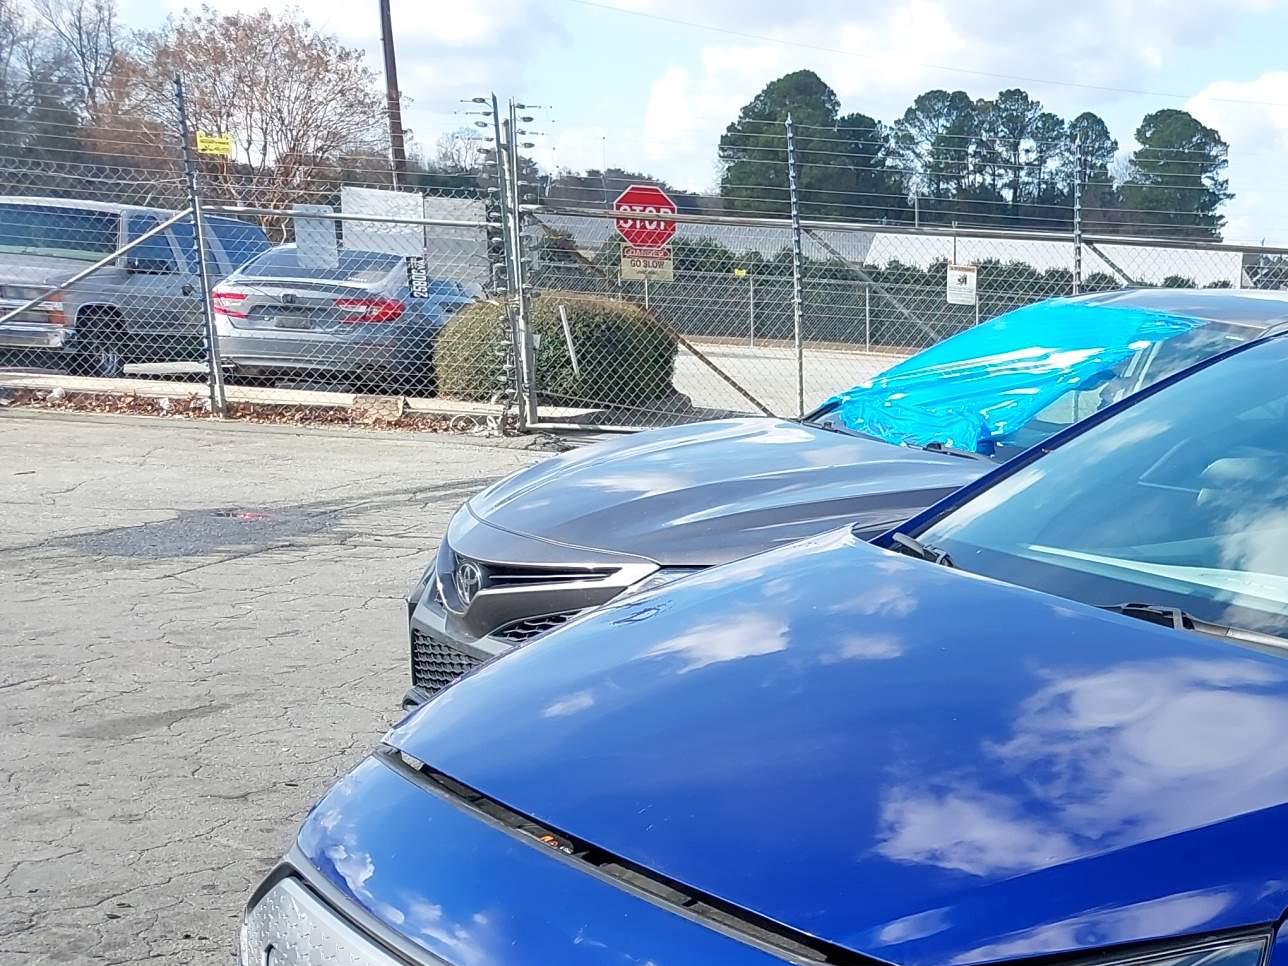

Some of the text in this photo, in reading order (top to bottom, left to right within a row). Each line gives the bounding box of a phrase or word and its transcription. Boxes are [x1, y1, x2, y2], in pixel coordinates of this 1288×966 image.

[619, 205, 672, 230] STOP
[630, 259, 665, 269] GO SLOW
